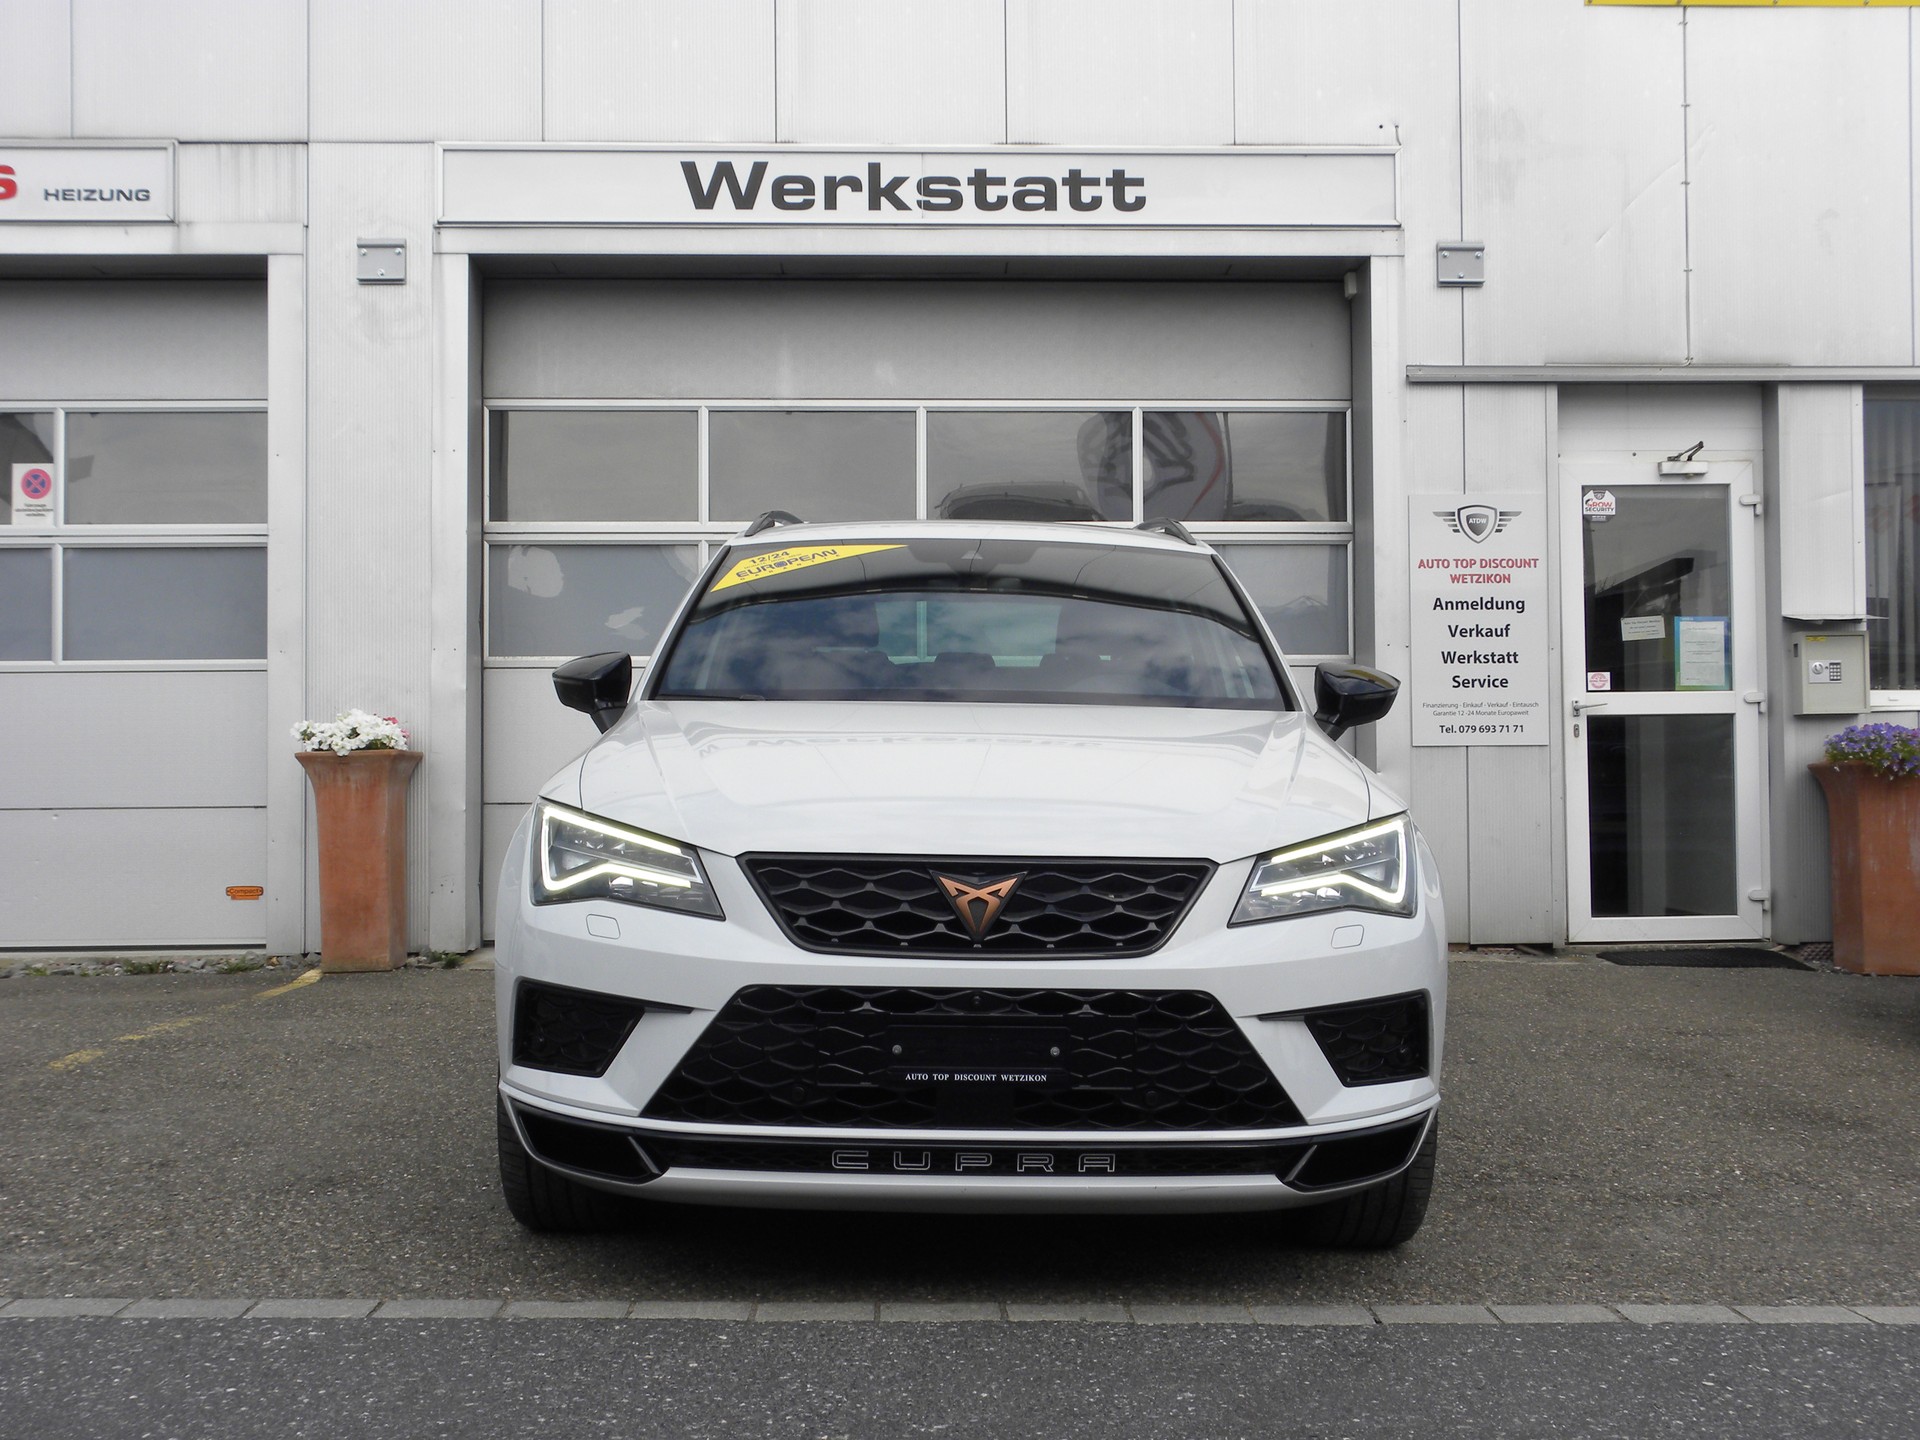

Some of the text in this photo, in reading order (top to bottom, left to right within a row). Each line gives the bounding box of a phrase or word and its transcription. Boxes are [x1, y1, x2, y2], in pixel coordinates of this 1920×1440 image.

[680, 161, 1147, 212] Werkstatt
[43, 188, 151, 202] HEIZUNG
[736, 549, 838, 578] EUROPEAN
[749, 551, 790, 564] 12/24
[1418, 558, 1539, 569] AUTO TOP DISCOUNT
[1450, 573, 1511, 584] WETZIKON
[1433, 597, 1525, 613] Anmeldung
[1448, 624, 1511, 638] Verkauf
[1441, 651, 1519, 664] Werkstatt
[1452, 675, 1509, 688] Service
[1422, 702, 1459, 710] Finanzierung
[1439, 725, 1524, 734] Tel. 079 693 71 71
[905, 1073, 1048, 1082] AUTO TOP DISCOUNT WETZIKON
[831, 1149, 1116, 1173] CUPRA
